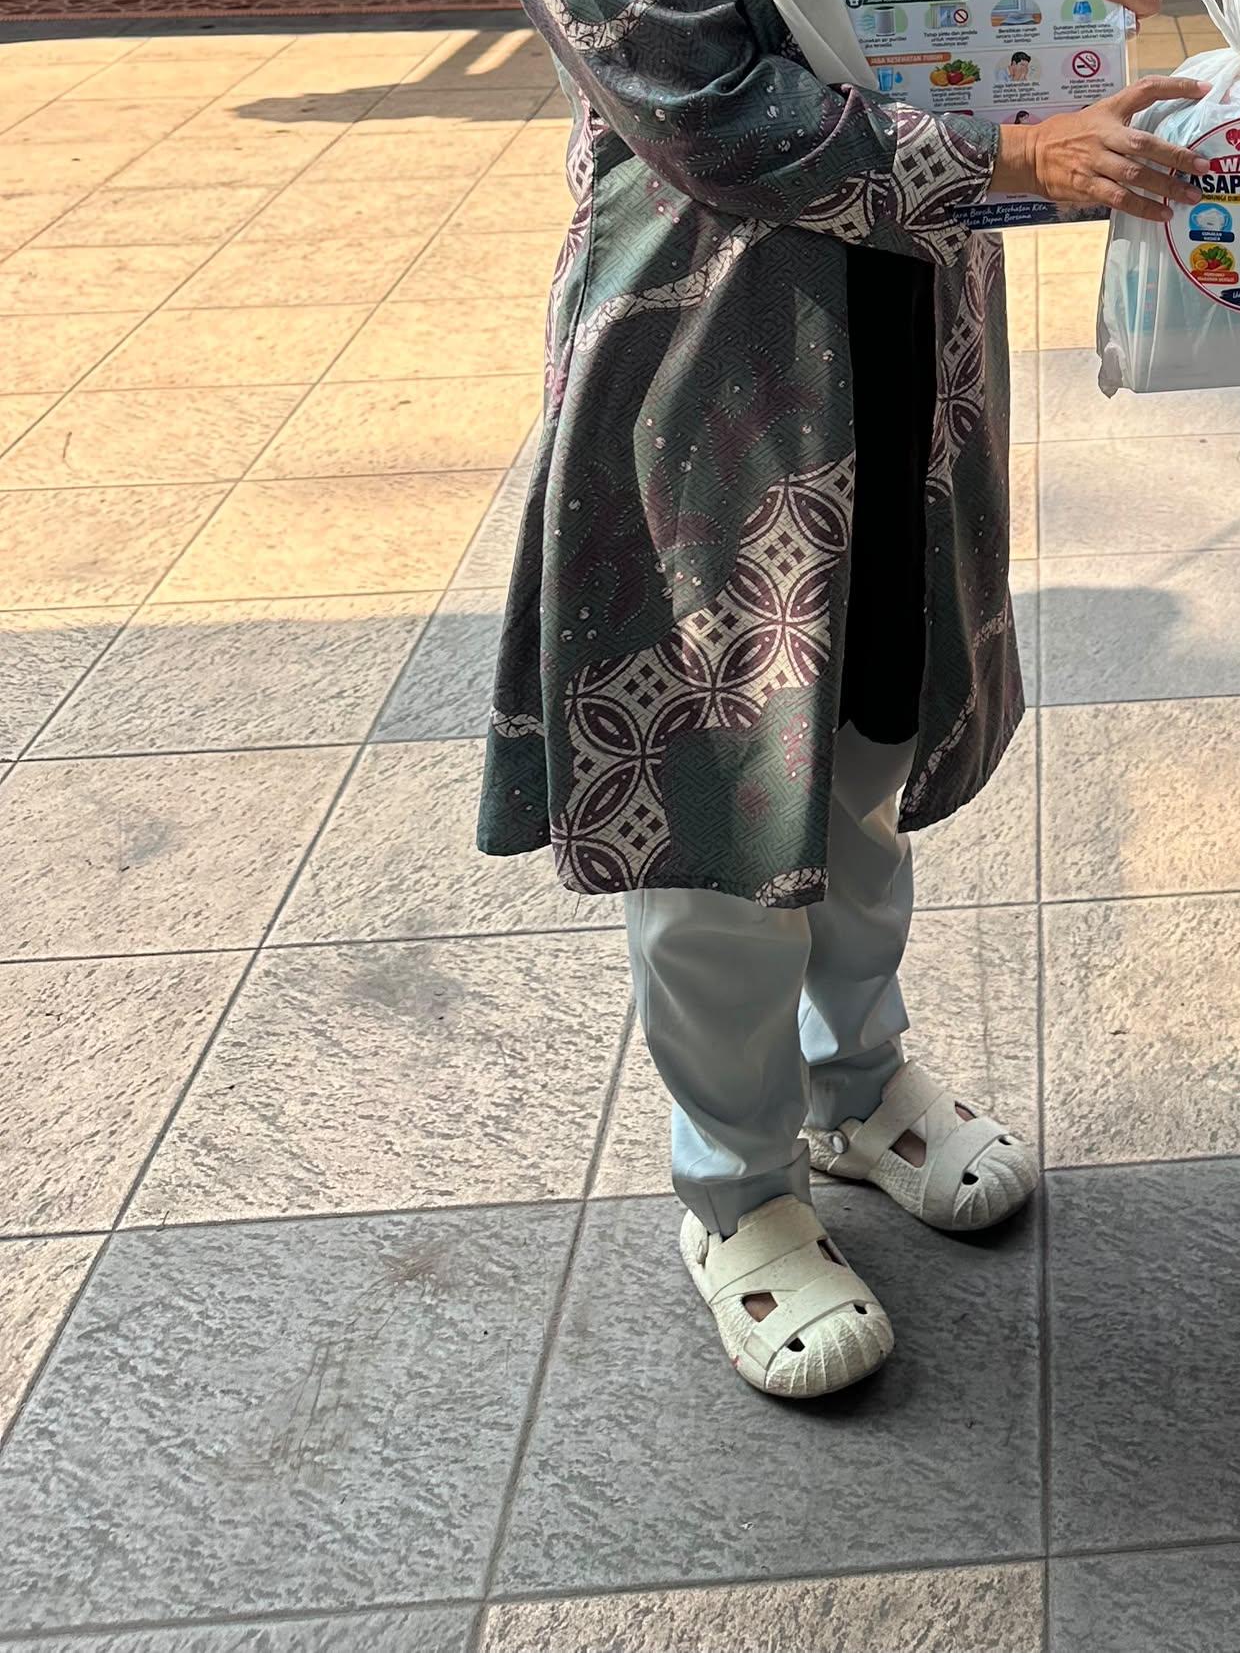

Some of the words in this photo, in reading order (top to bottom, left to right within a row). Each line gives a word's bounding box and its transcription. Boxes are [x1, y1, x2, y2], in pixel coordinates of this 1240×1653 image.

[996, 204, 1031, 215] Kesehatan
[982, 216, 1003, 226] Depan
[1004, 214, 1032, 222] Bersama
